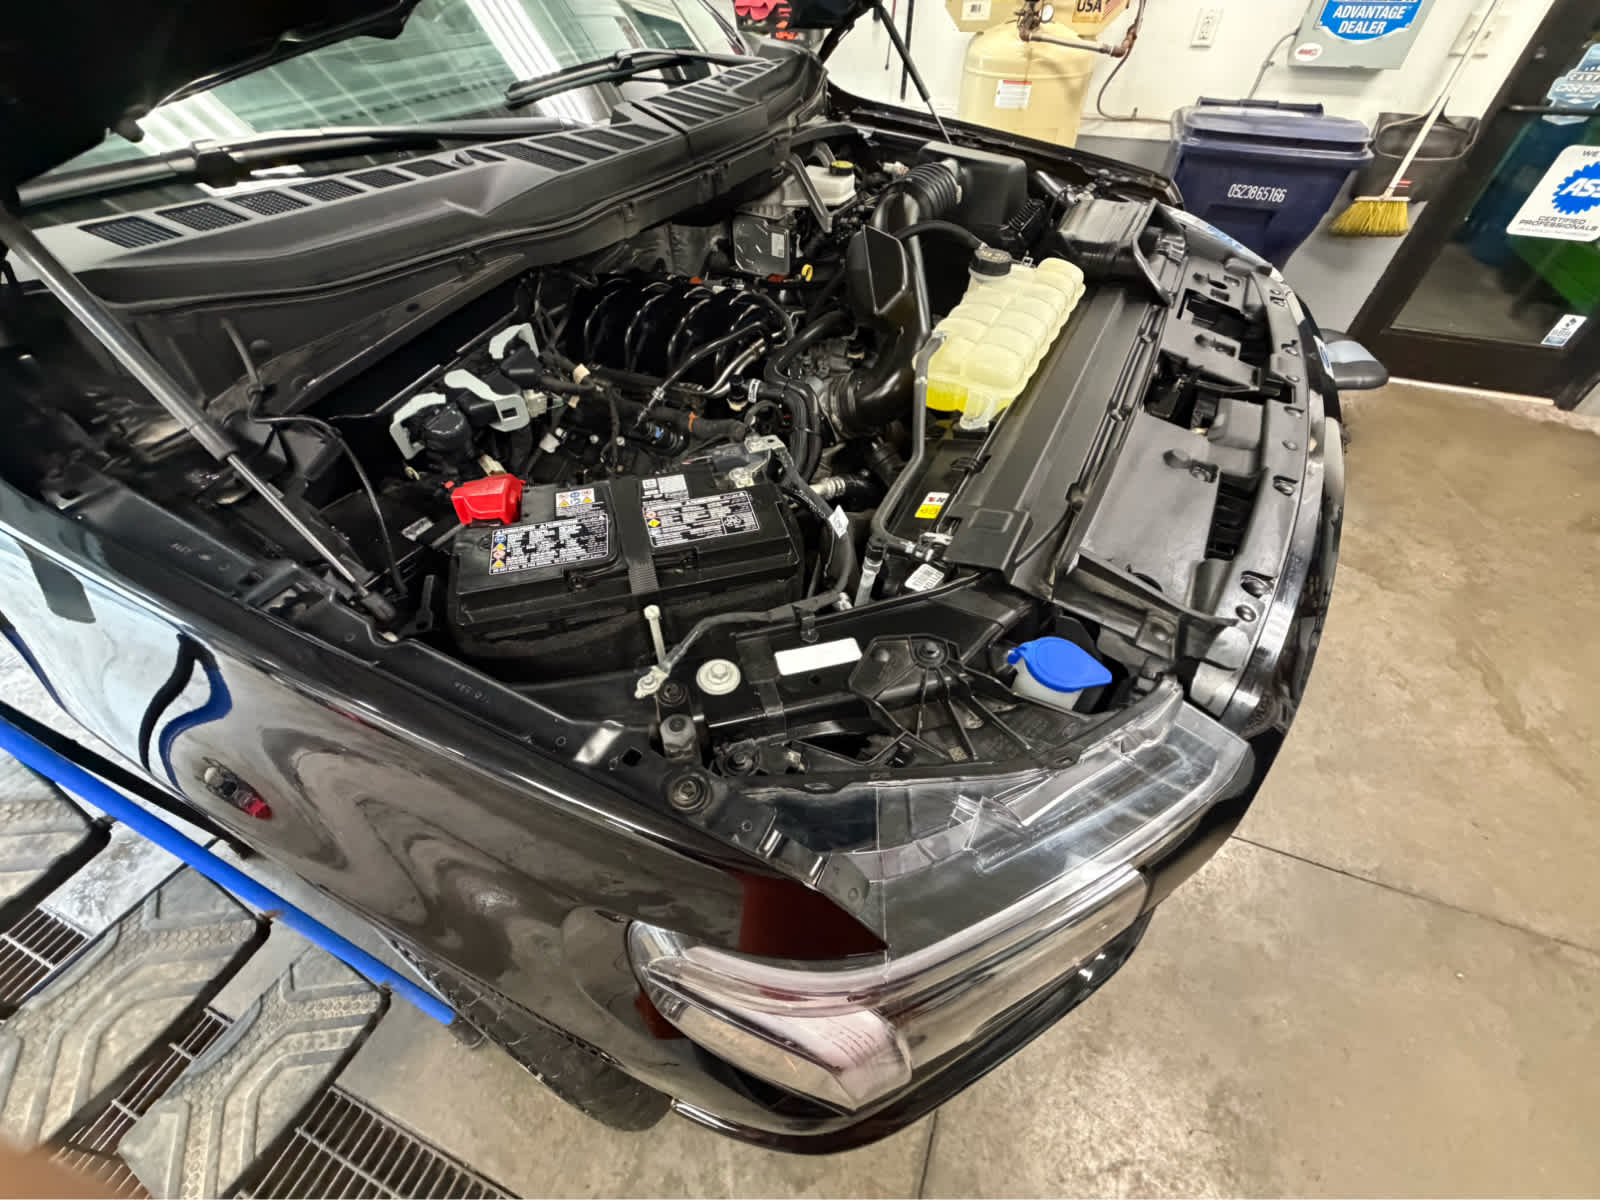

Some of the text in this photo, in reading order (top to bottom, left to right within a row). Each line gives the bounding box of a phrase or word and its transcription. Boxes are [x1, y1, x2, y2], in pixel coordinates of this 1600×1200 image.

[1077, 0, 1102, 13] USA
[1332, 5, 1407, 19] ADVANTAGE
[1338, 21, 1387, 34] DEALER
